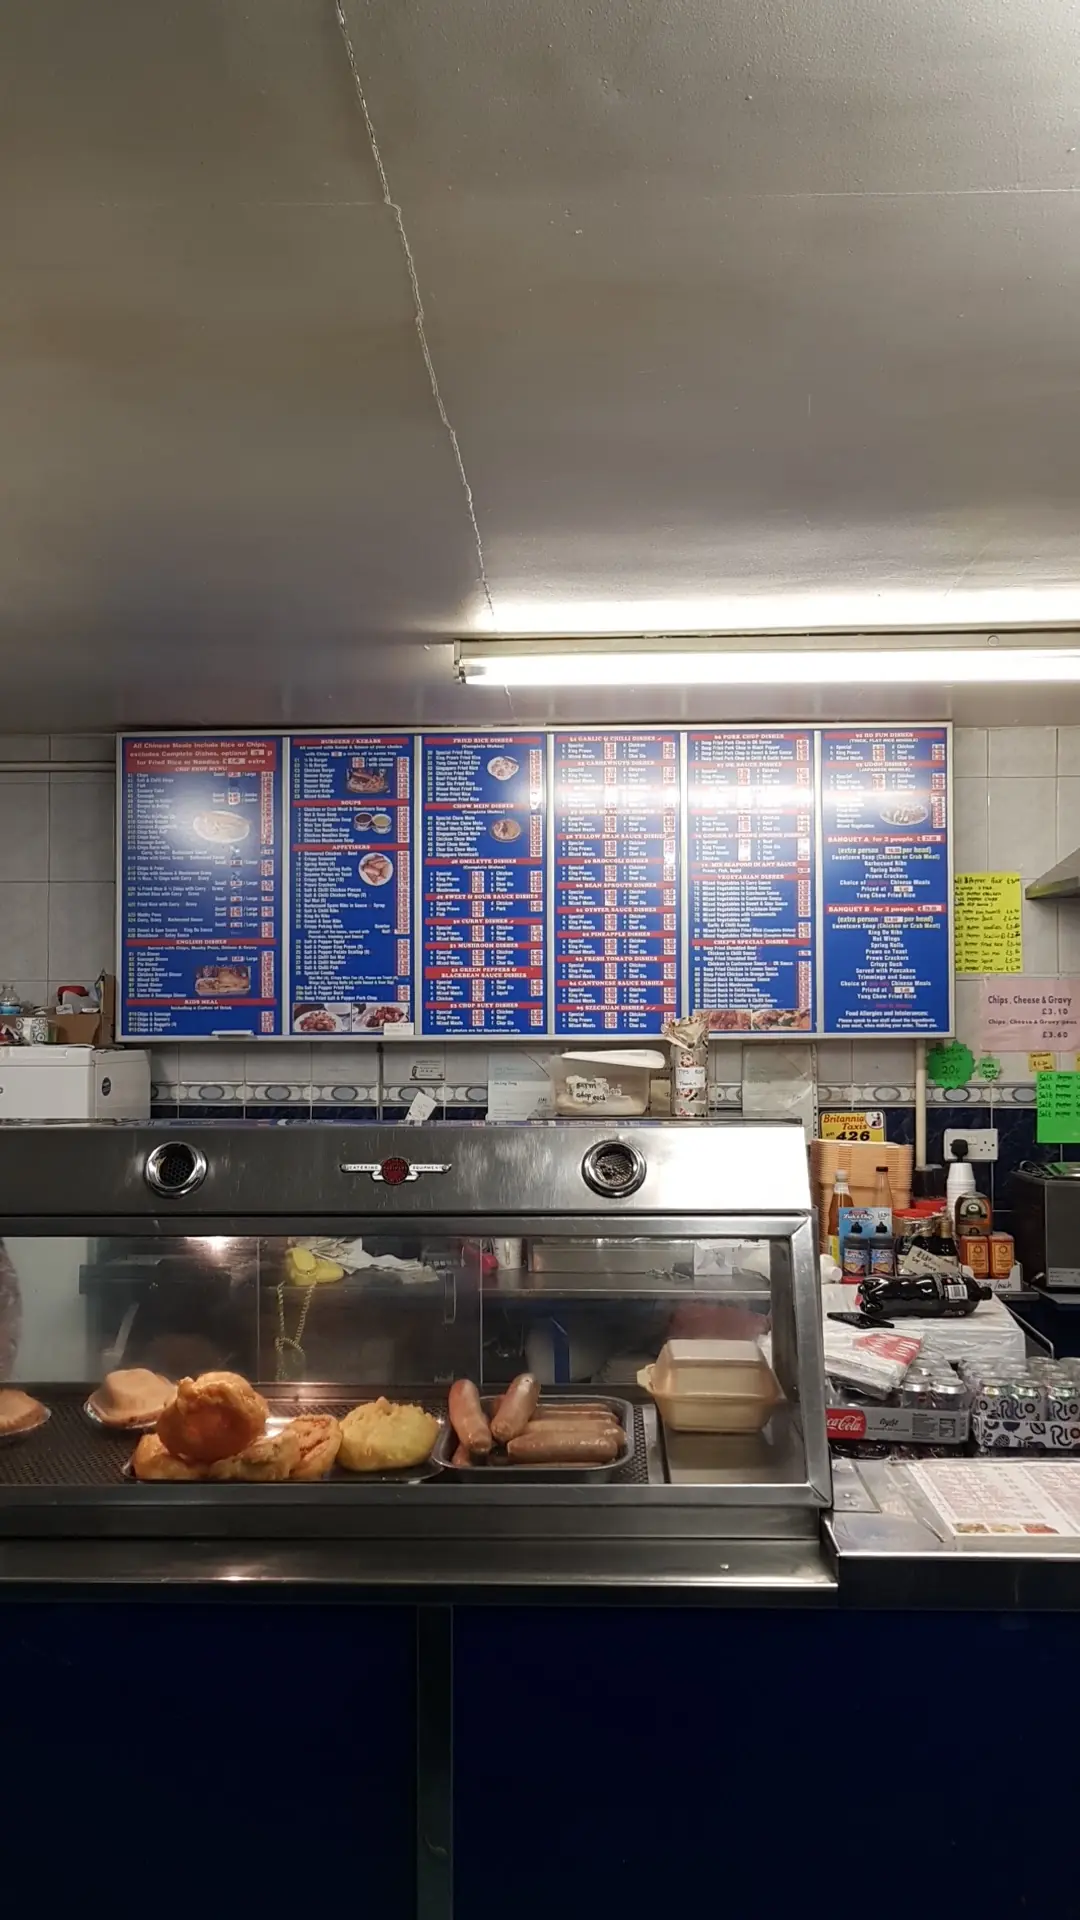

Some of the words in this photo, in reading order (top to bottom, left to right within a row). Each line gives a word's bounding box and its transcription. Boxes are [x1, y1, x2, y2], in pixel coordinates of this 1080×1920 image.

[1013, 995, 1040, 1003] Cheese
[1048, 996, 1072, 1006] Gravy
[823, 1115, 864, 1123] Britannia
[836, 1131, 870, 1141] 426
[1052, 1400, 1079, 1420] RIO
[826, 1415, 862, 1431] ca-Cola
[1050, 1425, 1080, 1446] RIO
